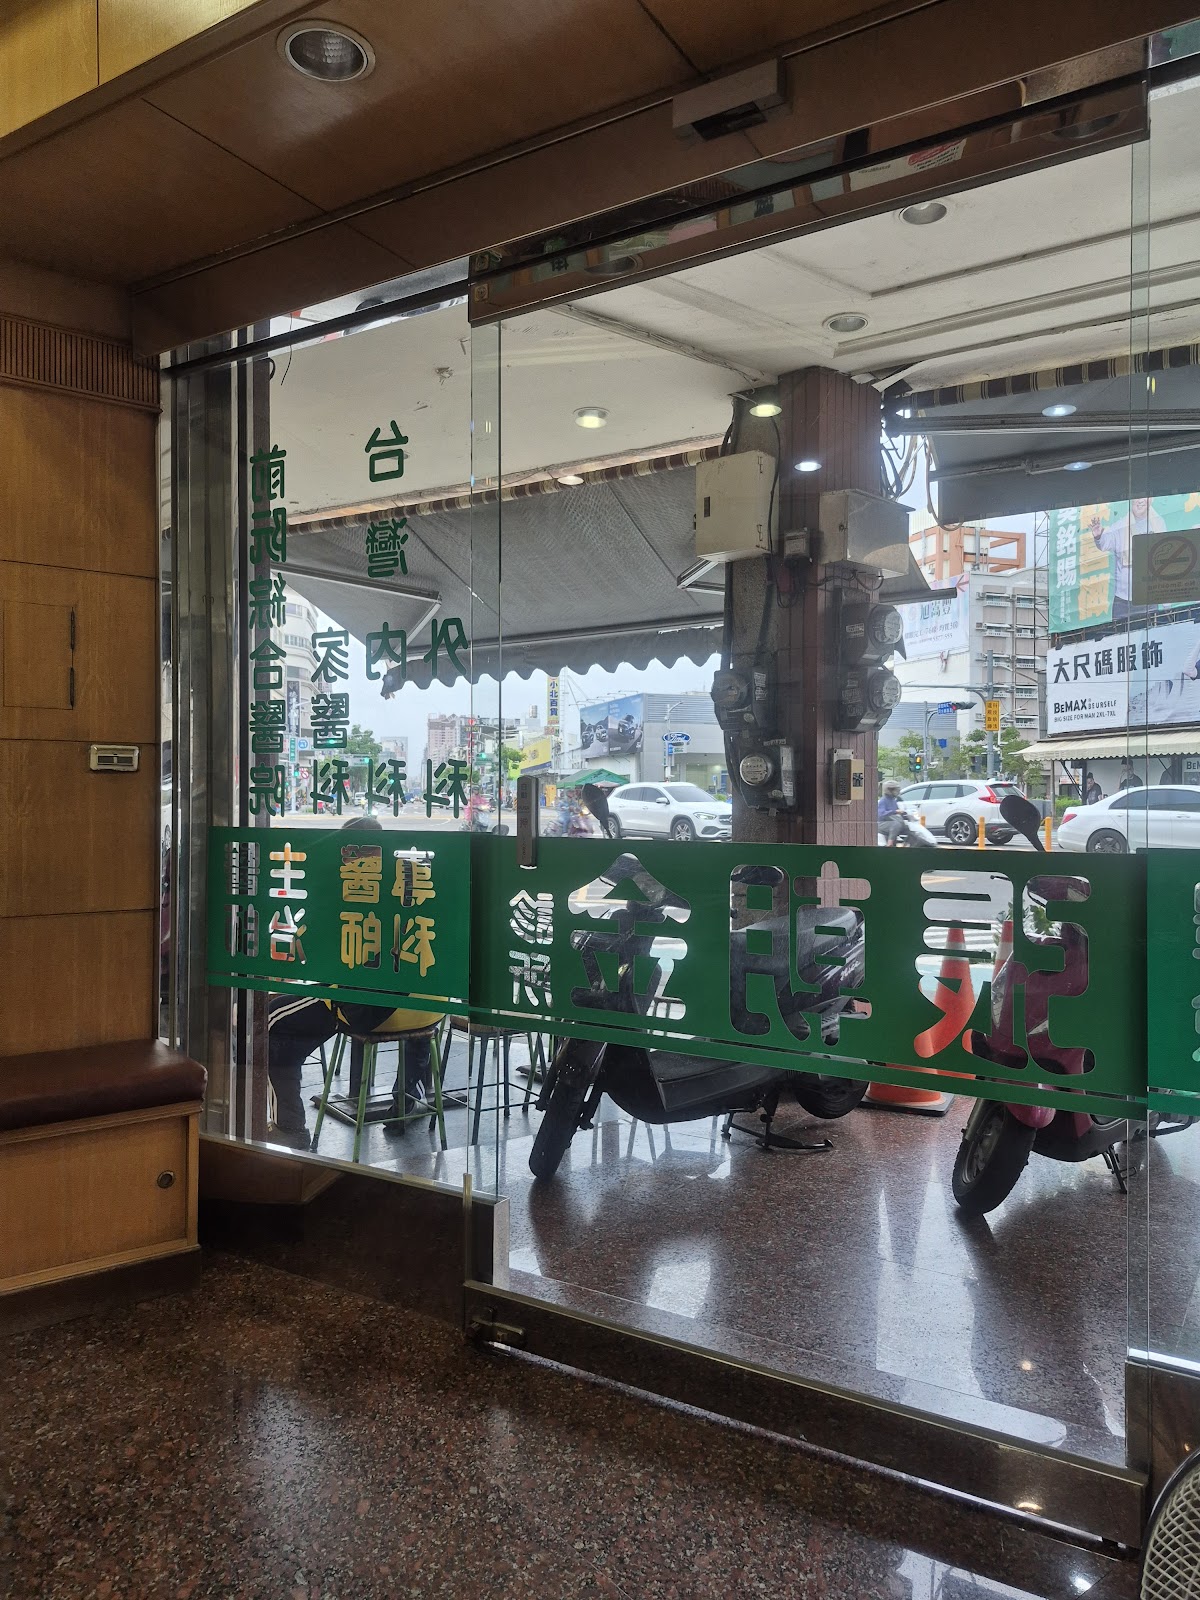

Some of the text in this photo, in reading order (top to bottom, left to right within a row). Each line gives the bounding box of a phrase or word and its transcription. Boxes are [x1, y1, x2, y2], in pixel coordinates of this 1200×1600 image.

[1053, 639, 1163, 683] 大尺碼服飾
[550, 681, 559, 716] 小北百貨
[1063, 714, 1073, 722] SIZE
